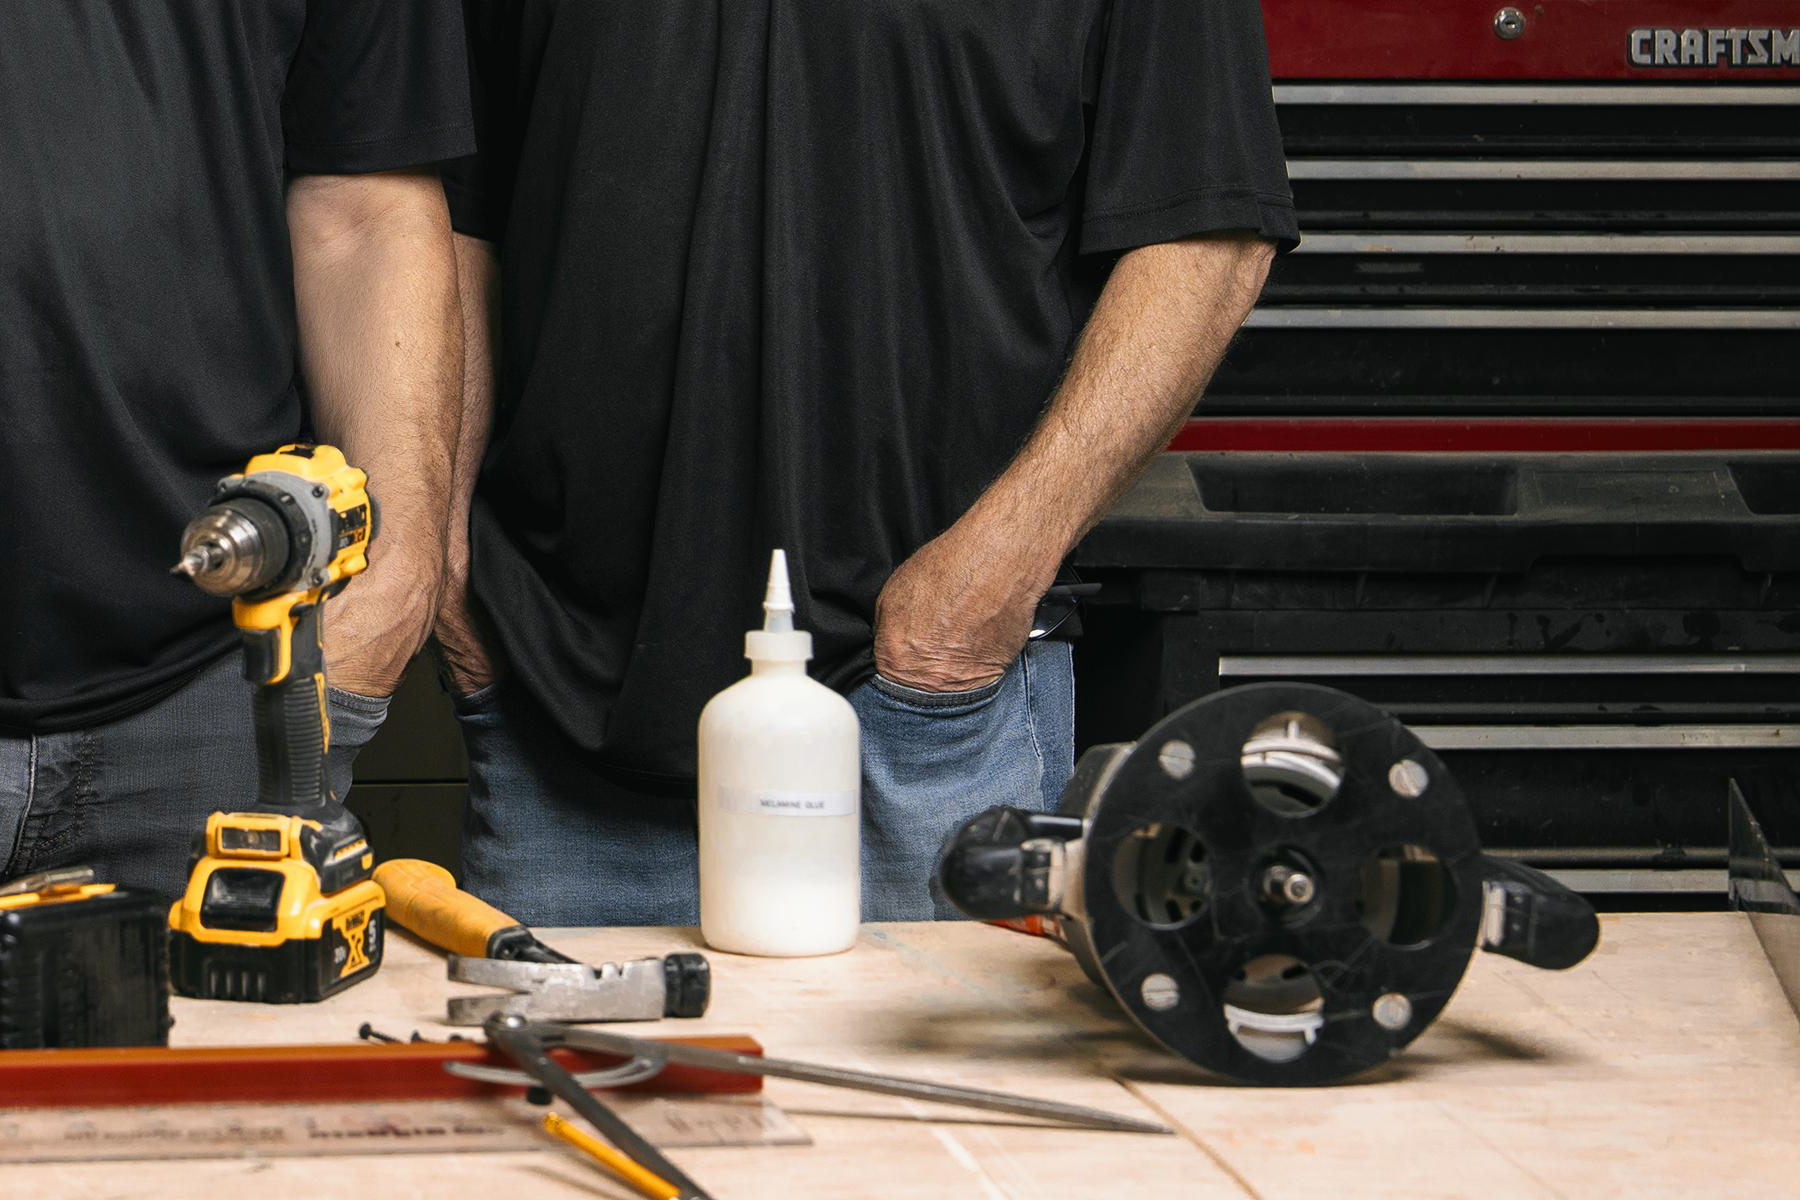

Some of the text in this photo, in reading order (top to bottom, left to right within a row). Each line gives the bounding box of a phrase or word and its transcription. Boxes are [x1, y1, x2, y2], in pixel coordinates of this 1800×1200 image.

[1629, 27, 1800, 66] CRAFTSM
[760, 799, 825, 809] MELAMINE GLUE
